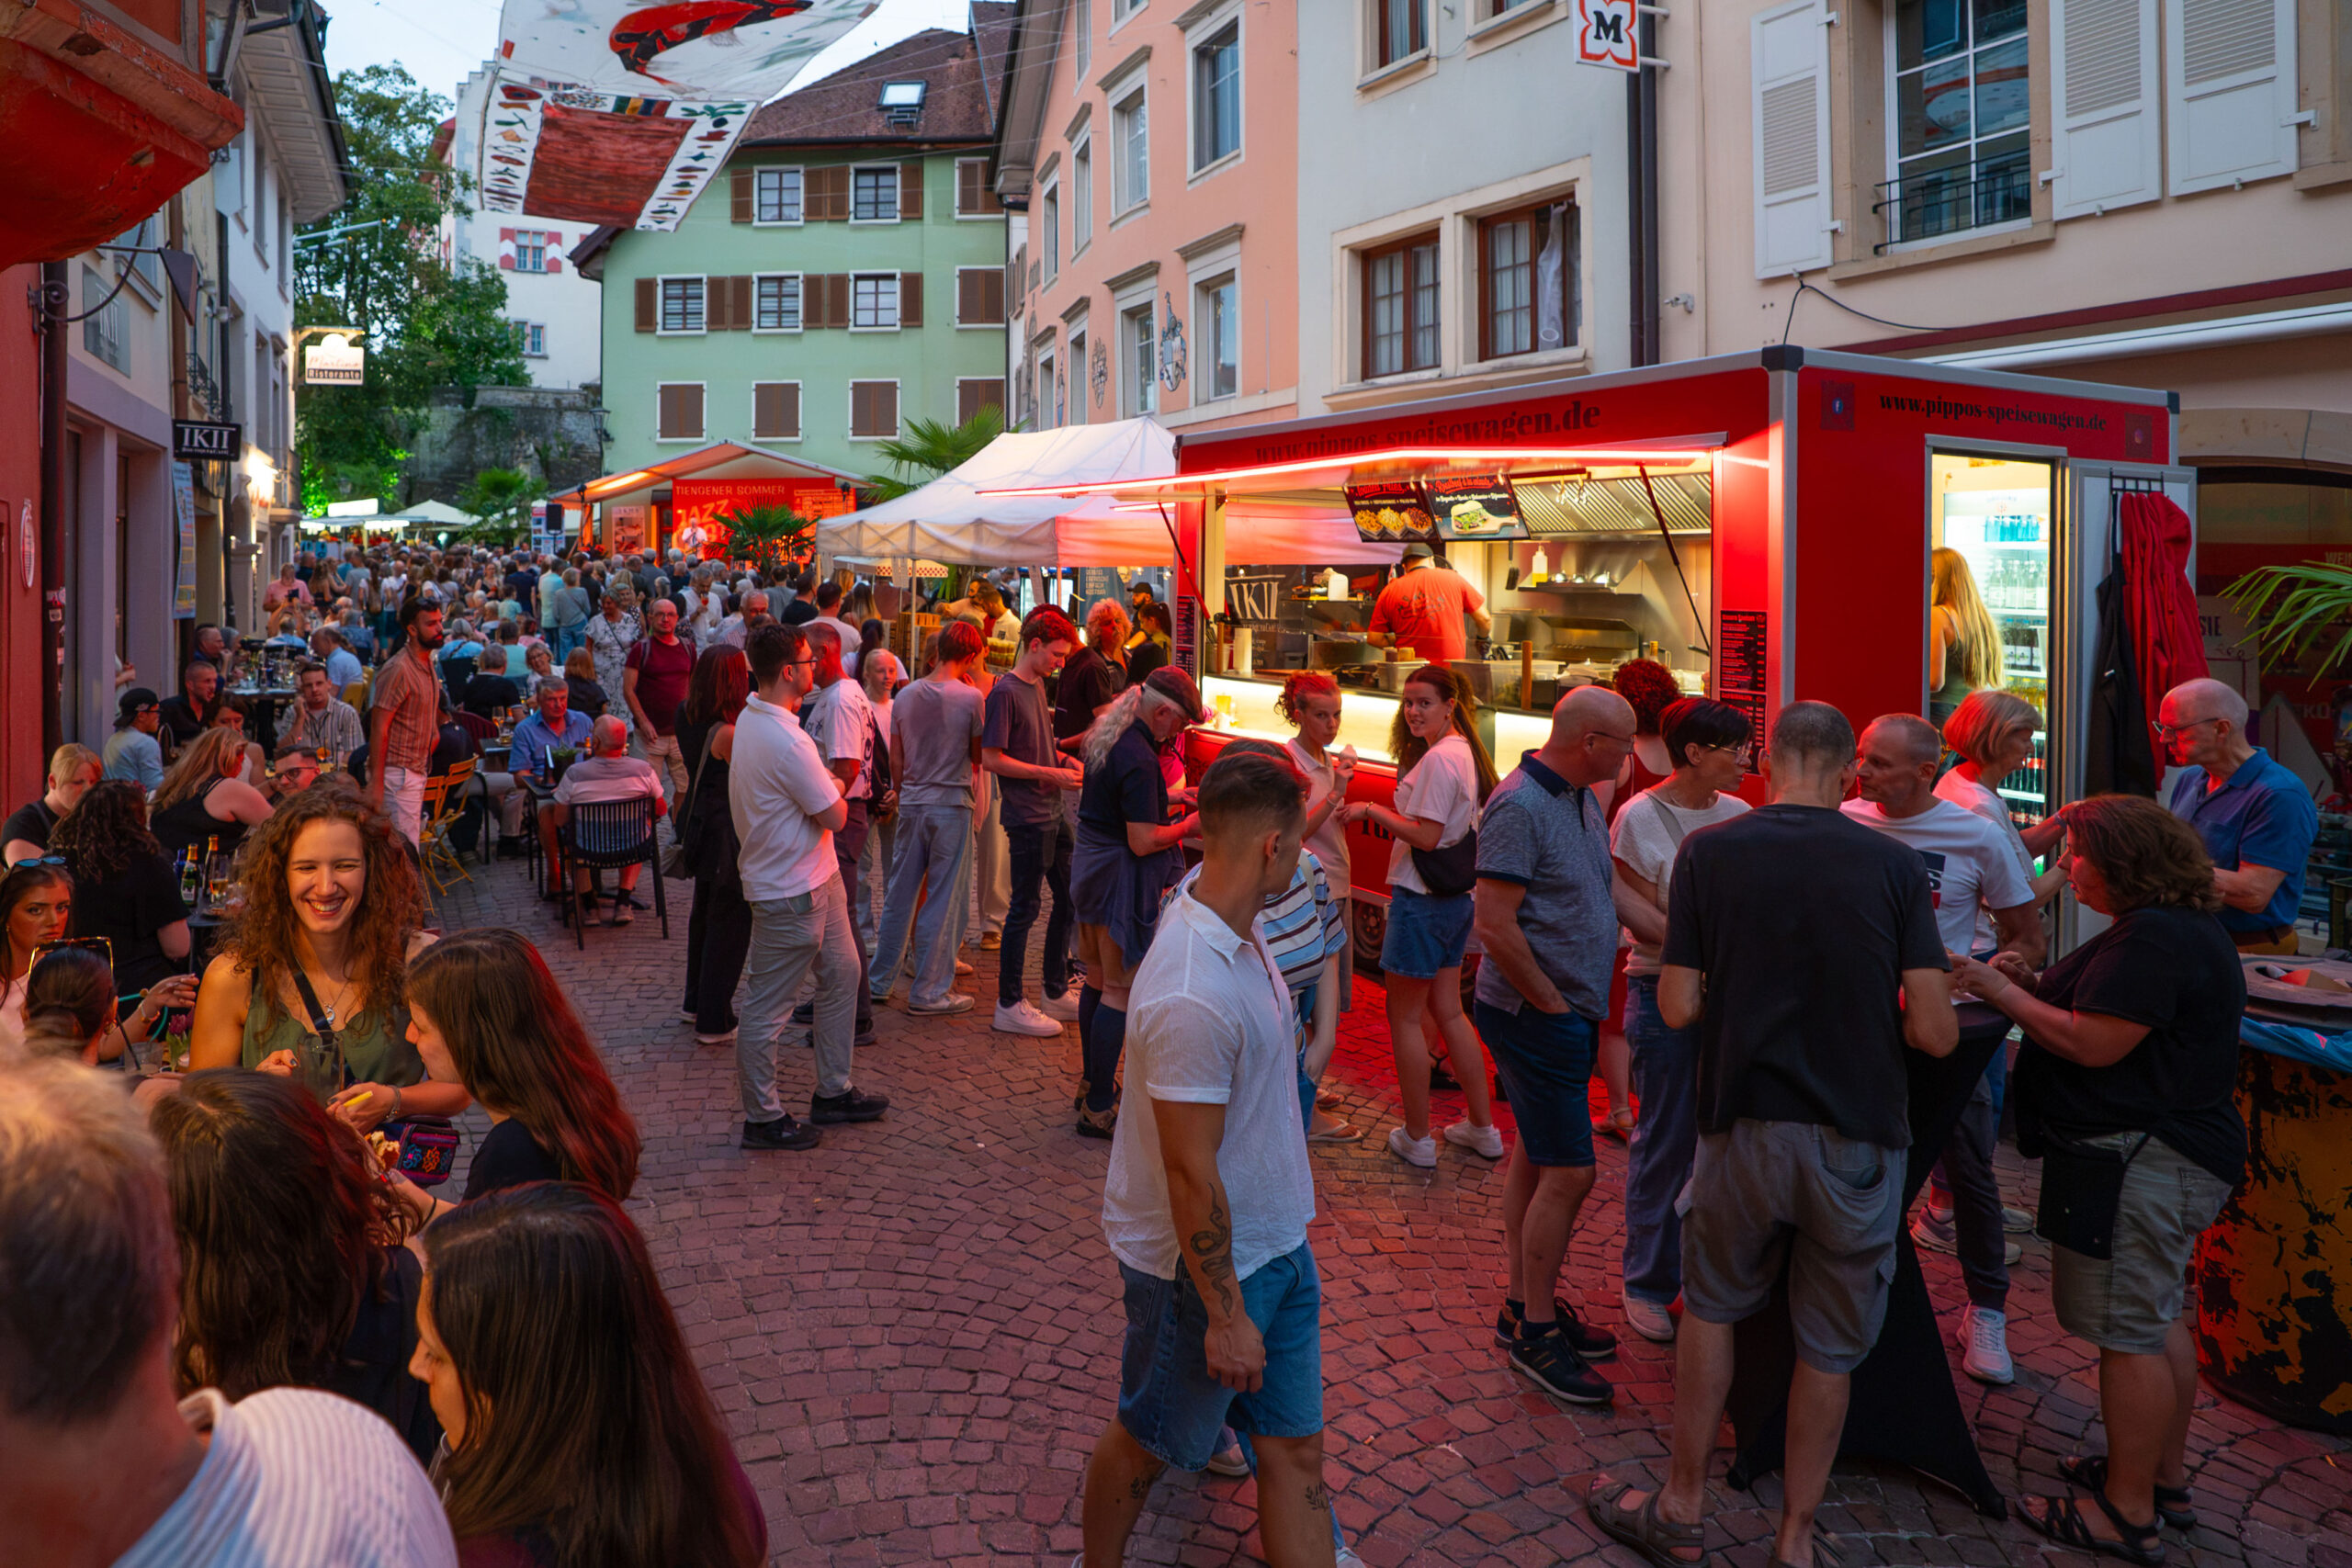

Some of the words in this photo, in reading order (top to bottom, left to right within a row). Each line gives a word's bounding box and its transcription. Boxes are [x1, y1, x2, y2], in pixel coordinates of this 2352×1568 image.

[1593, 10, 1623, 44] M
[308, 369, 360, 379] Ristorante
[1880, 395, 2107, 431] www.pippos-speisewagen.de
[676, 486, 732, 495] TIENGENER
[737, 485, 785, 495] SOMMER
[678, 499, 729, 525] JAZZ
